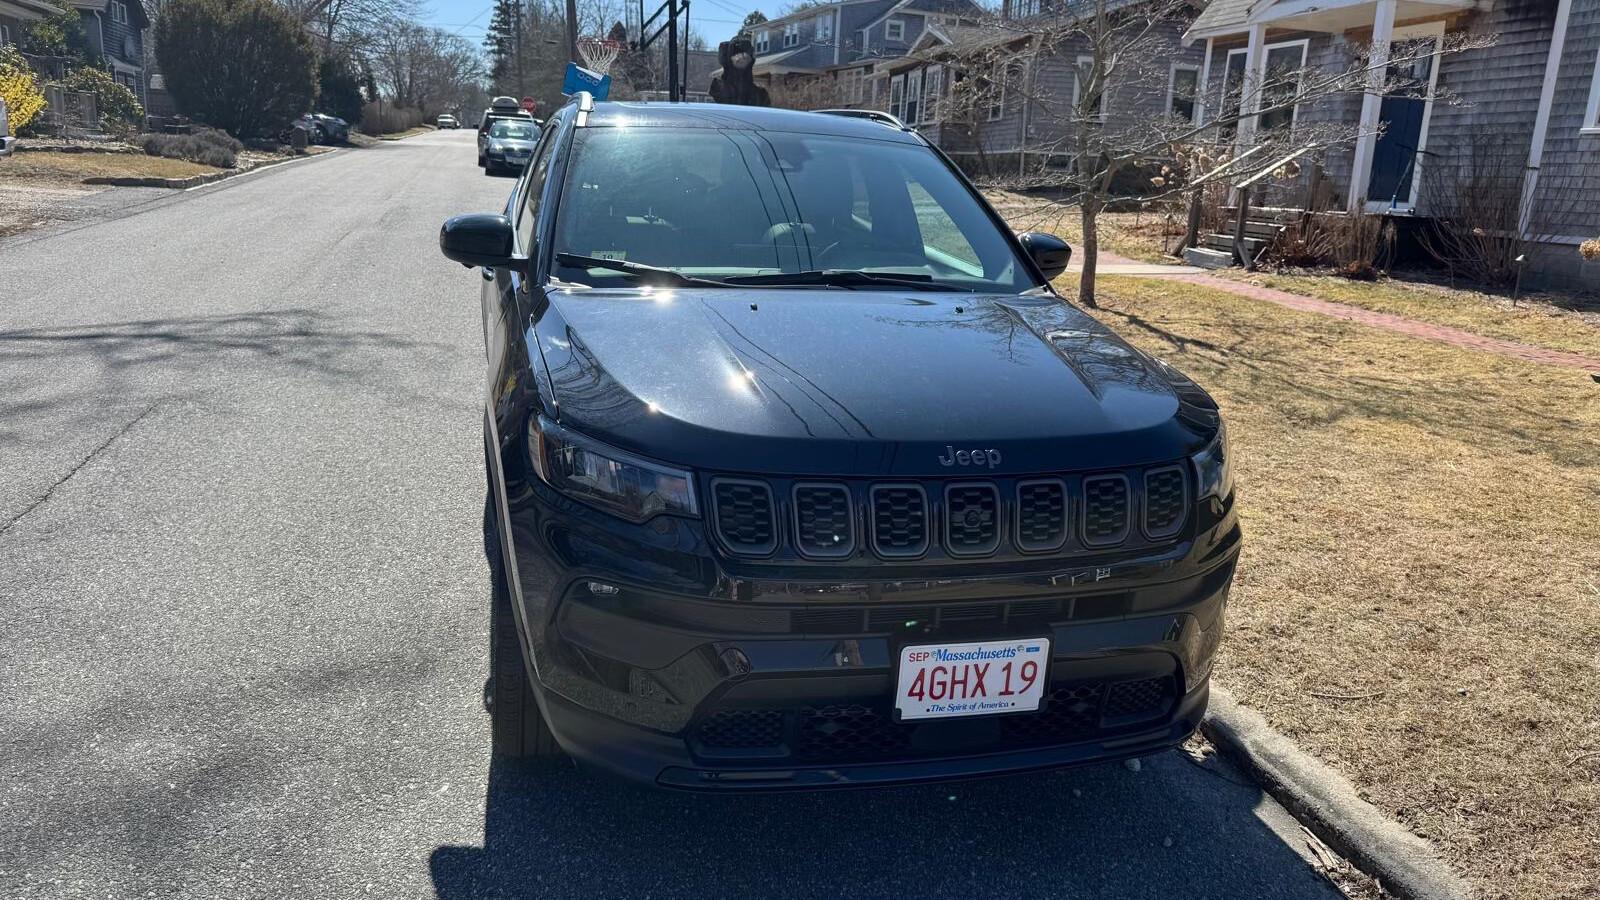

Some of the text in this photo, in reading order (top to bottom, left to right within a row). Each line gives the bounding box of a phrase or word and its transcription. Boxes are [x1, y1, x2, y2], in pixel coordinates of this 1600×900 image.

[938, 445, 1002, 469] Jeep
[909, 652, 930, 662] SEP
[936, 647, 1016, 662] Massachusetts
[907, 661, 1038, 702] 4GHX 19
[930, 701, 1009, 713] The Spirit of America
